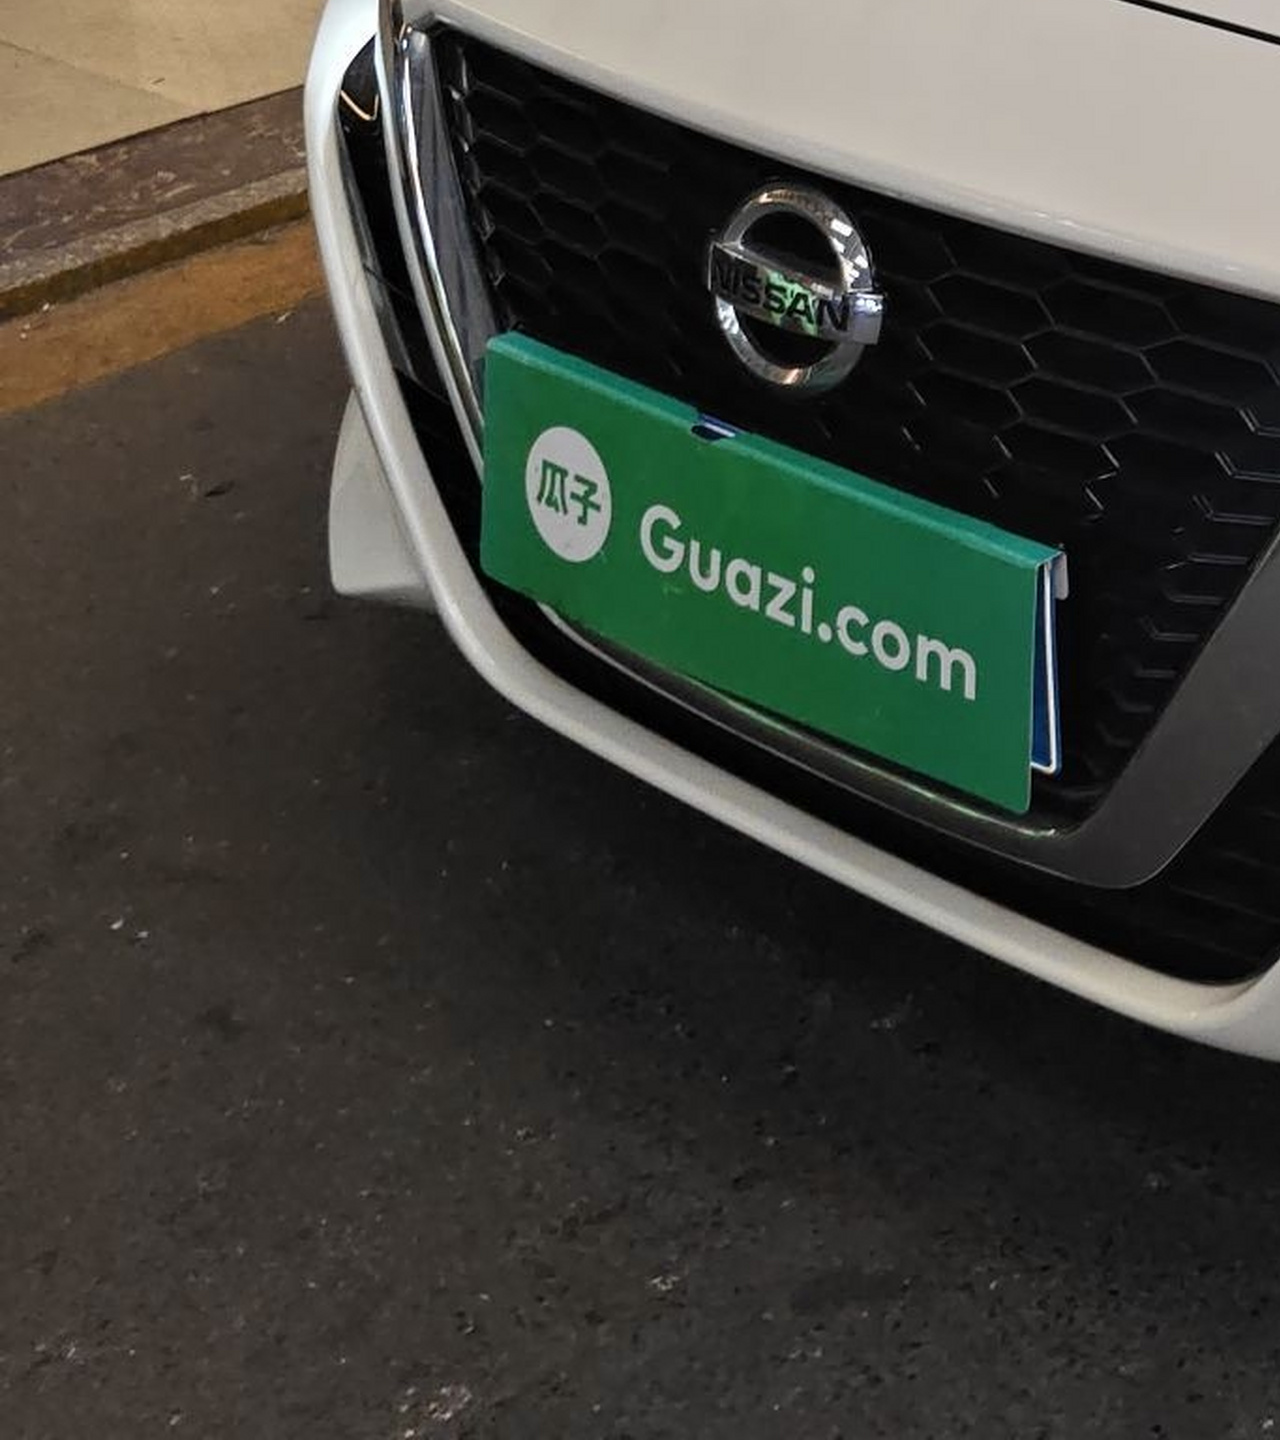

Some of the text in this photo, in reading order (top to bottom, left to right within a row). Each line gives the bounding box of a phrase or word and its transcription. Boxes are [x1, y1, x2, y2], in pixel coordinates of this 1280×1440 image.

[711, 260, 850, 332] NISSAN
[536, 458, 602, 527] 瓜子
[640, 504, 977, 701] Guazi.com
